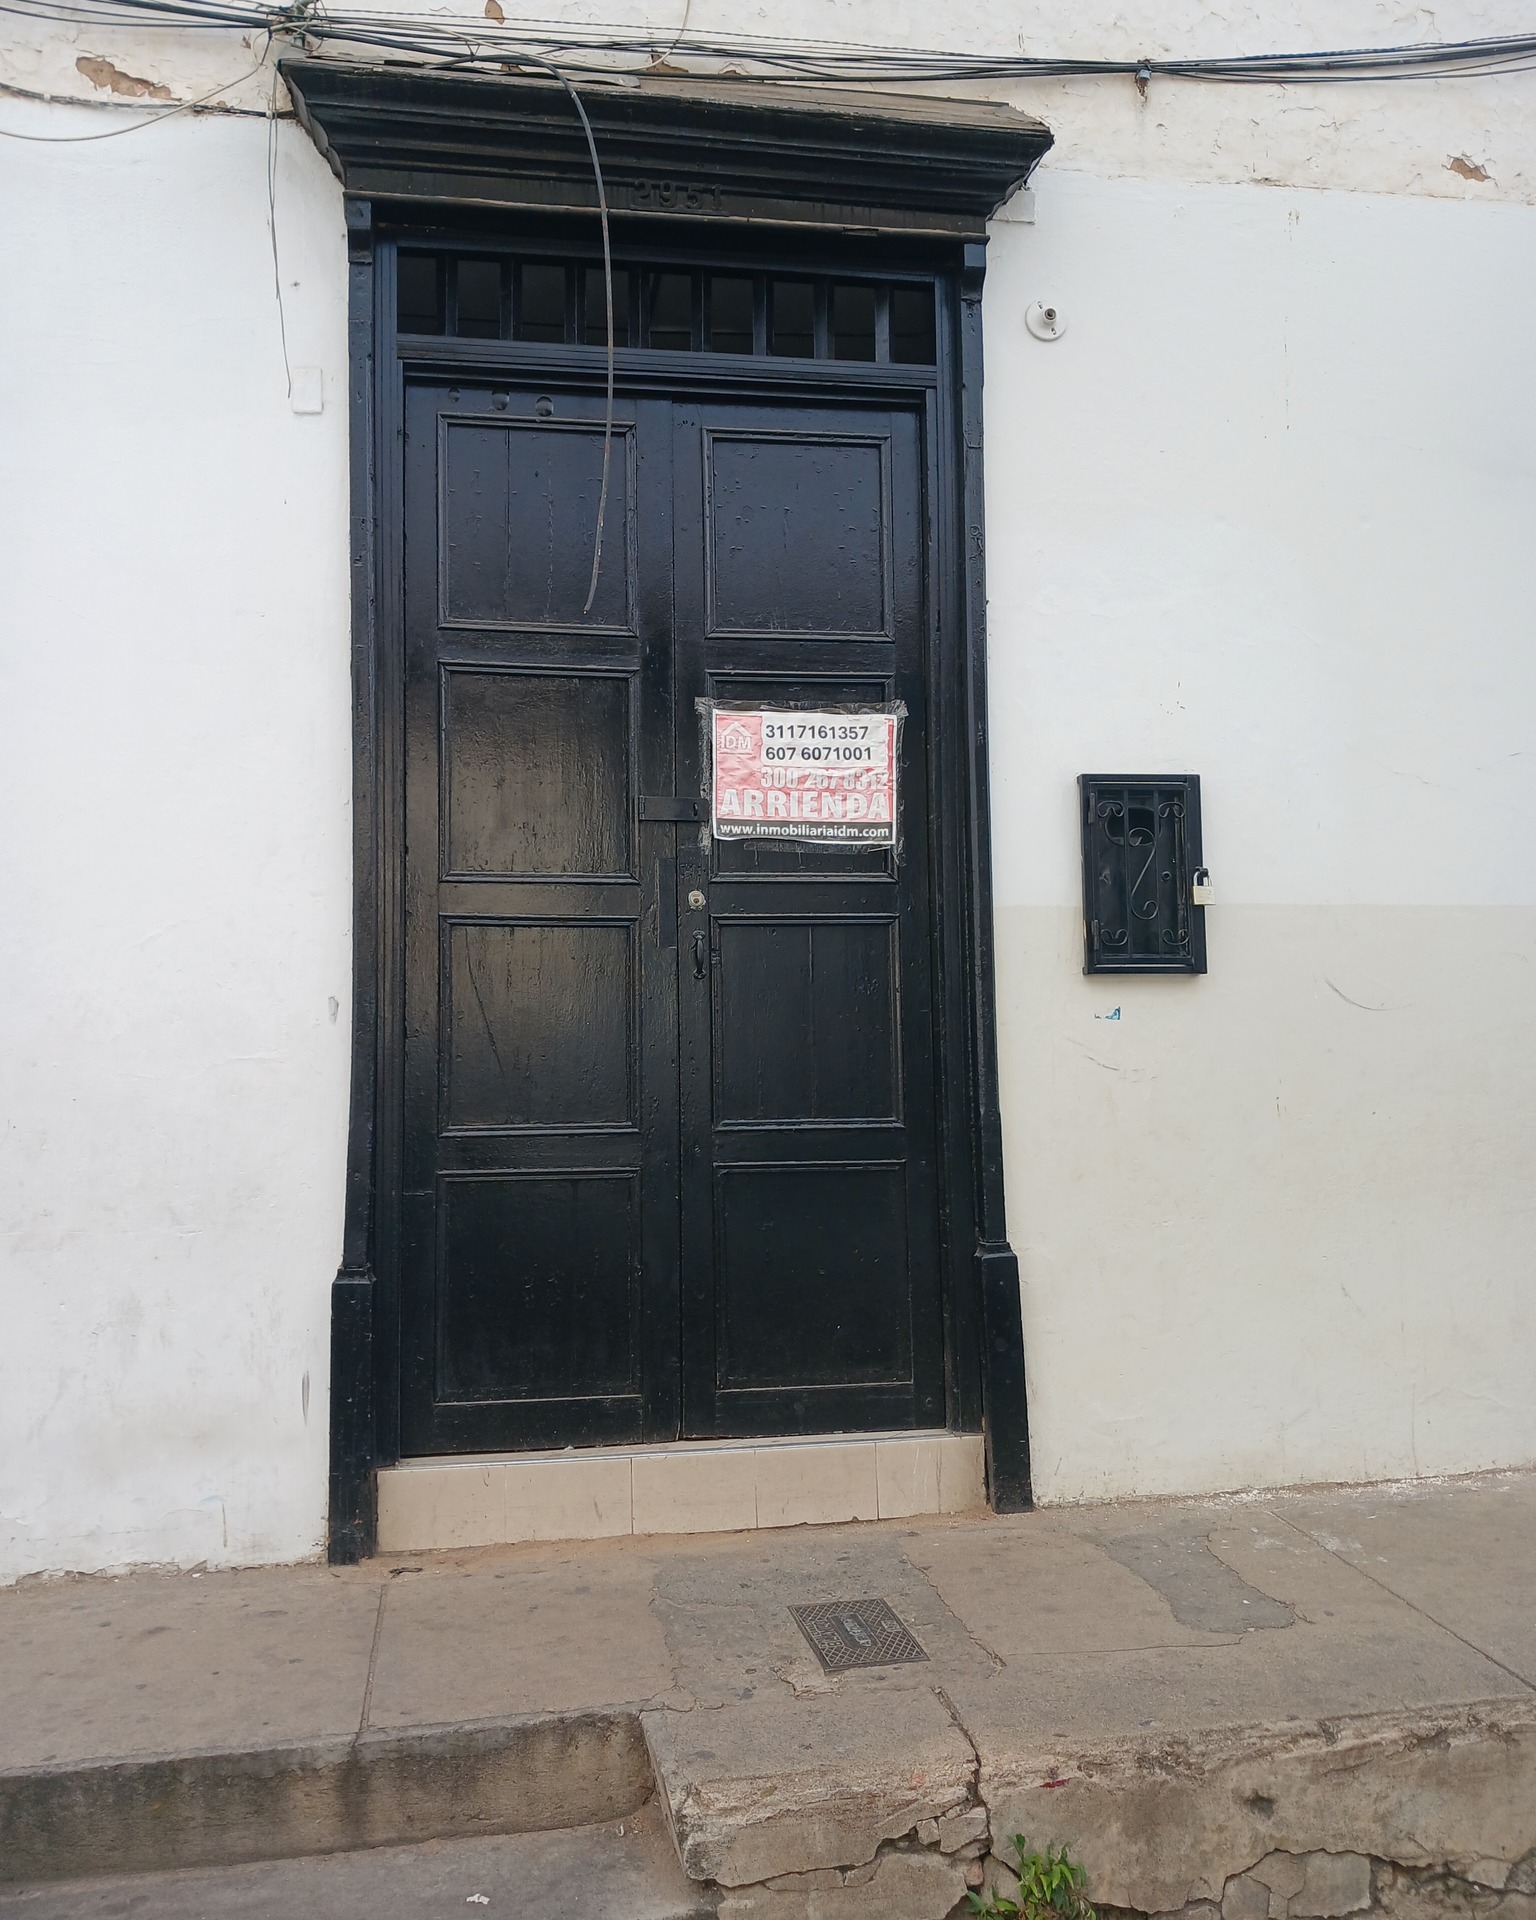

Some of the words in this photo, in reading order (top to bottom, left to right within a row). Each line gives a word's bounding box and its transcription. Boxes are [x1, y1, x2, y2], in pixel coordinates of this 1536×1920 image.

[633, 178, 723, 211] 2951
[765, 724, 869, 741] 3117161357
[720, 735, 752, 752] IDM
[765, 746, 796, 761] 607
[800, 747, 872, 761] 6071001
[760, 767, 799, 789] 300
[803, 768, 839, 790] 267
[842, 769, 889, 791] 8312
[719, 789, 890, 819] ARRIENDA
[719, 823, 889, 838] www.inmobiliariaidm.com
